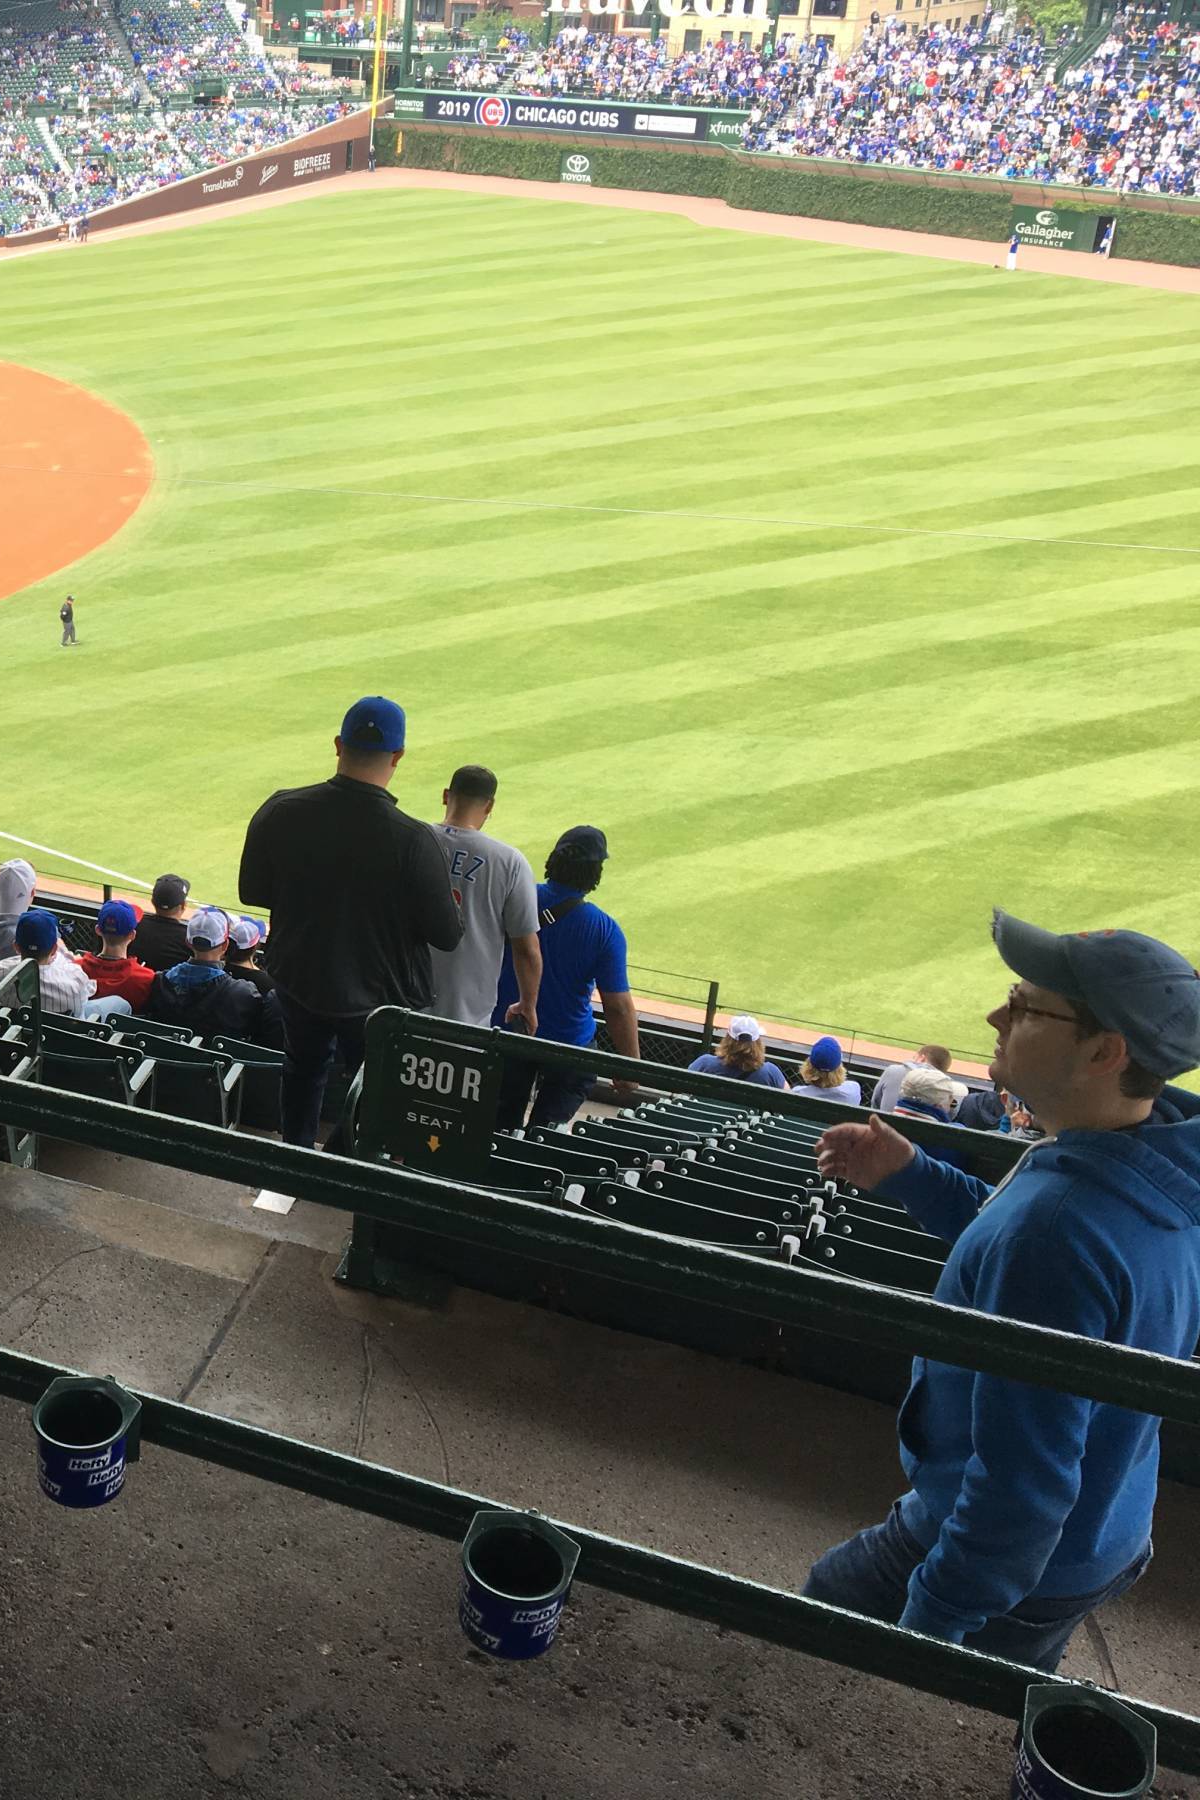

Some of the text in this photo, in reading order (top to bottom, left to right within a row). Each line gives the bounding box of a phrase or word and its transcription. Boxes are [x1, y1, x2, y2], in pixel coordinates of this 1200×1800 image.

[438, 100, 471, 117] 2019
[516, 105, 577, 125] CHICAGO
[580, 110, 619, 128] CUBS
[293, 152, 332, 171] BIOFREEZE
[202, 178, 239, 193] TransUnion
[561, 172, 592, 183] TOYOTA
[1015, 222, 1075, 240] Gallagher
[1020, 237, 1064, 248] INSURANCE
[449, 850, 485, 884] EZ
[400, 1052, 482, 1102] 330 R
[406, 1111, 452, 1131] SEAT
[70, 1454, 111, 1470] Hefty
[89, 1460, 123, 1485] Hefty
[513, 1601, 558, 1622] Hefty
